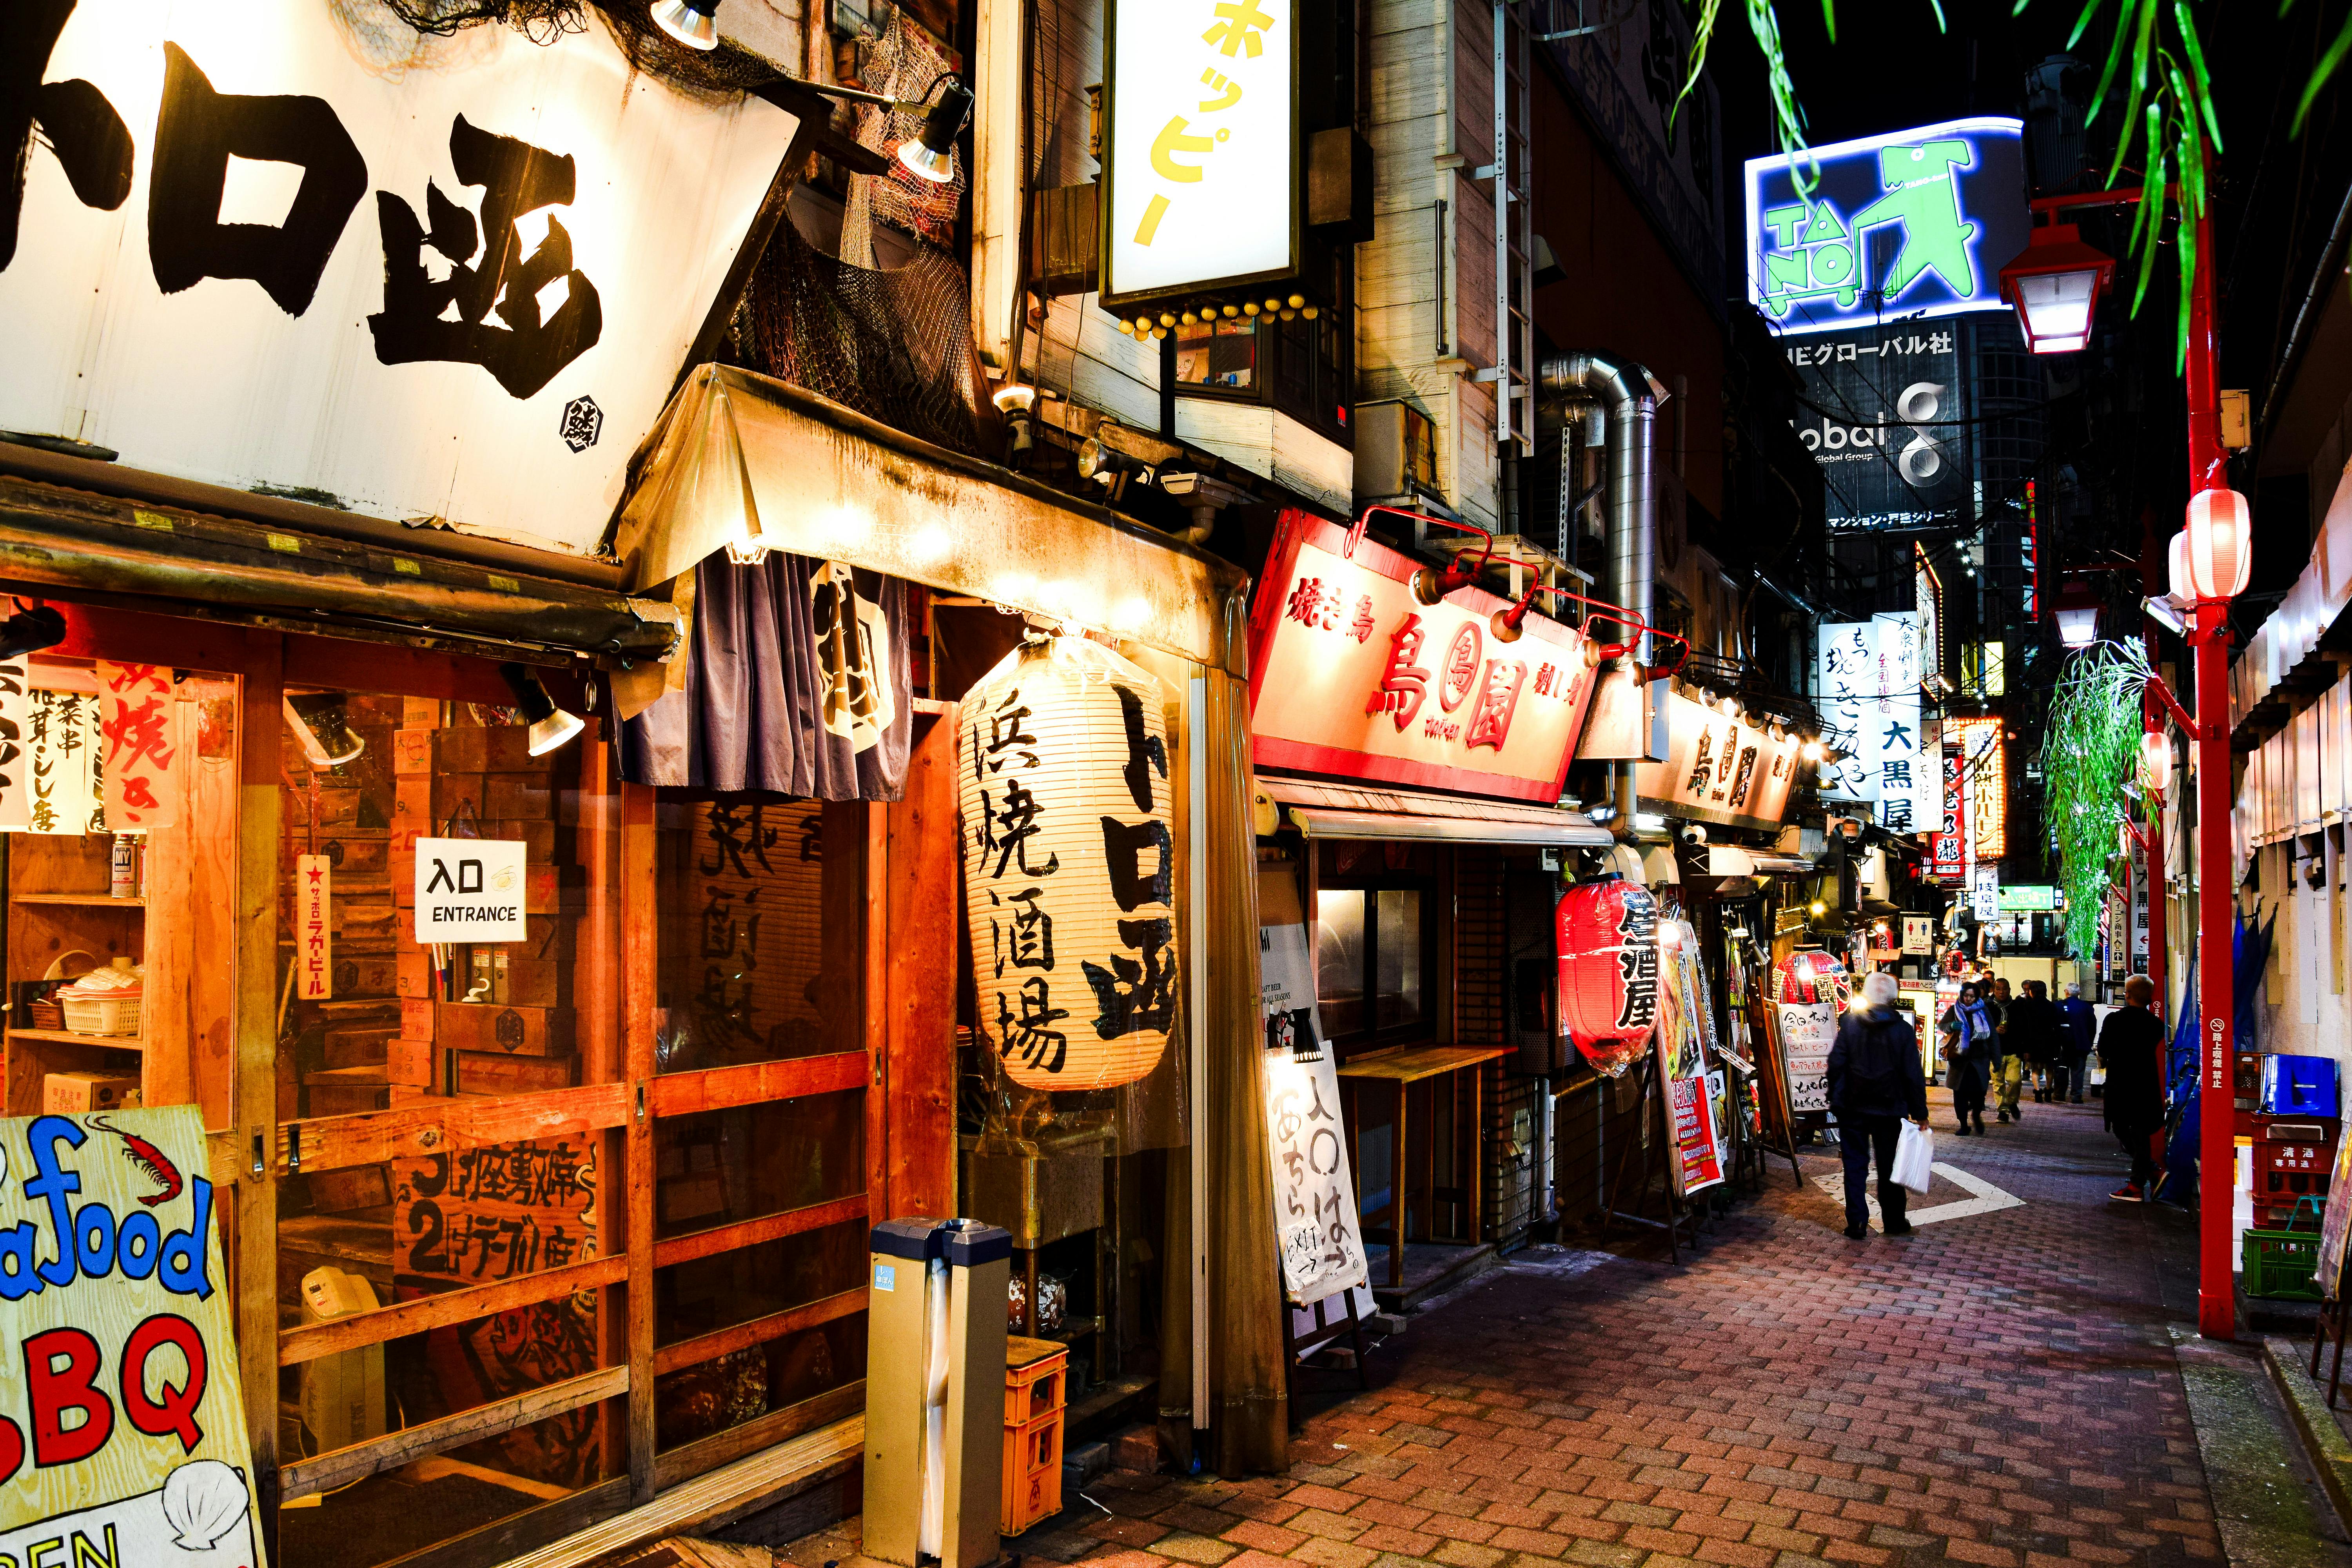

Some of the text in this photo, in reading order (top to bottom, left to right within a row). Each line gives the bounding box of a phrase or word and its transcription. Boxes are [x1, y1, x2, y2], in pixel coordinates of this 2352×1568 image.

[1134, 0, 1275, 247] ホッピー
[1846, 452, 1873, 461] Group
[1289, 578, 1375, 643] 焼き鳥
[1534, 662, 1583, 706] 刺し身
[1878, 653, 1890, 714] 全国地酒
[1883, 721, 1912, 833] 大黒屋
[116, 851, 131, 864] MY
[426, 858, 483, 894] 入口
[1081, 683, 1174, 1040] トロ函
[973, 688, 1069, 1073] 浜焼酒場
[1979, 882, 1993, 916] 岐阜屋
[432, 906, 517, 922] ENTRANCE
[1617, 890, 1659, 1029] 居酒屋
[1271, 983, 1281, 992] BEER
[1274, 992, 1291, 1002] SEASONS
[1789, 1043, 1809, 1053] ロースト
[2212, 1033, 2222, 1088] 路上喫煙 禁止
[1272, 1088, 1306, 1218] あちら
[2283, 1147, 2314, 1158] 清酒
[1287, 1225, 1317, 1263] EXIT
